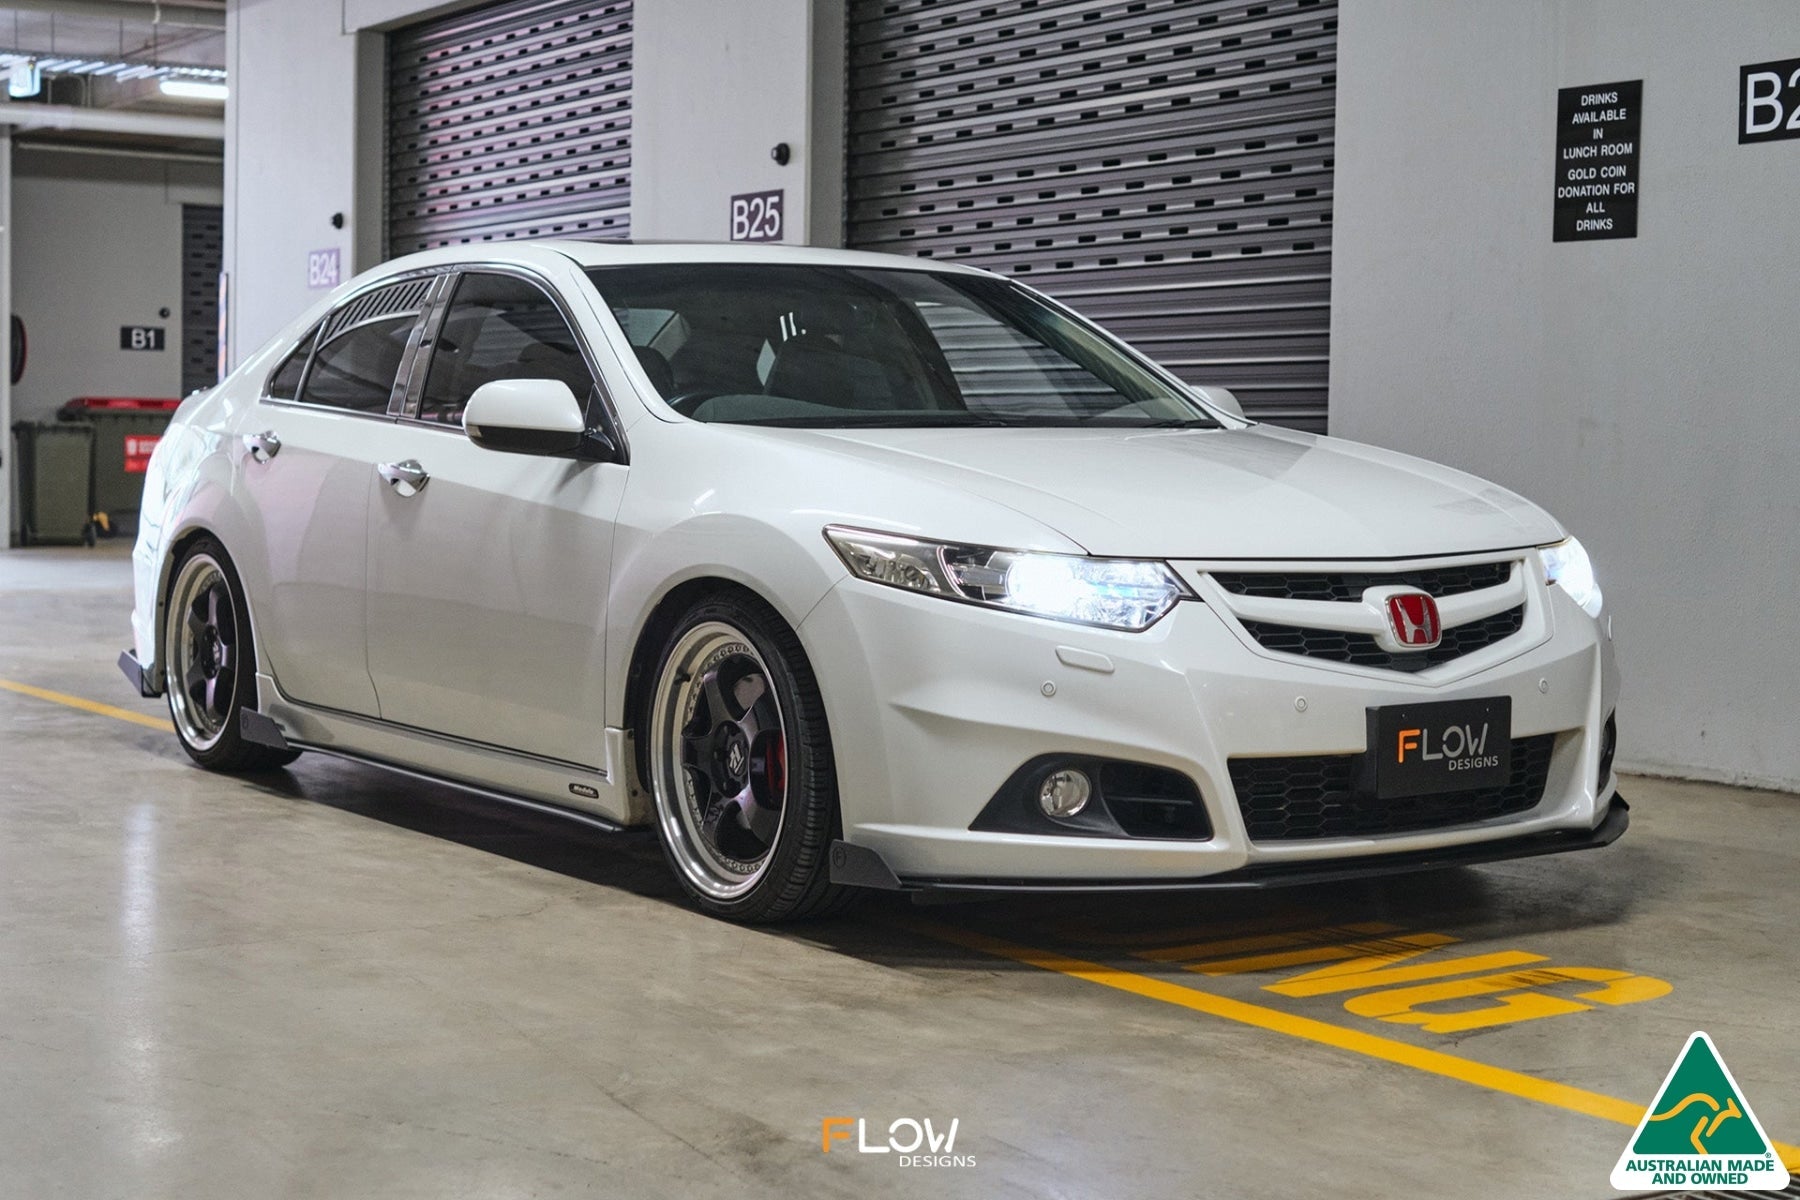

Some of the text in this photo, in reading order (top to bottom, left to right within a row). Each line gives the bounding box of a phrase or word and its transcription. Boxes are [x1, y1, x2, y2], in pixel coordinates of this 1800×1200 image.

[1581, 91, 1618, 106] DRINKS
[1571, 108, 1627, 125] AVAILABLE
[1593, 128, 1603, 139] IN
[1563, 142, 1633, 159] LUNCH ROOM
[1568, 165, 1626, 180] GOLD COIN
[1558, 182, 1635, 198] DONATION FOR
[1586, 201, 1605, 213] ALL
[733, 196, 780, 240] B25
[1576, 218, 1613, 231] DRINKS
[310, 252, 337, 285] B24
[131, 328, 155, 349] B1
[1398, 722, 1488, 763] FLOW
[1449, 756, 1499, 770] DESIGNS
